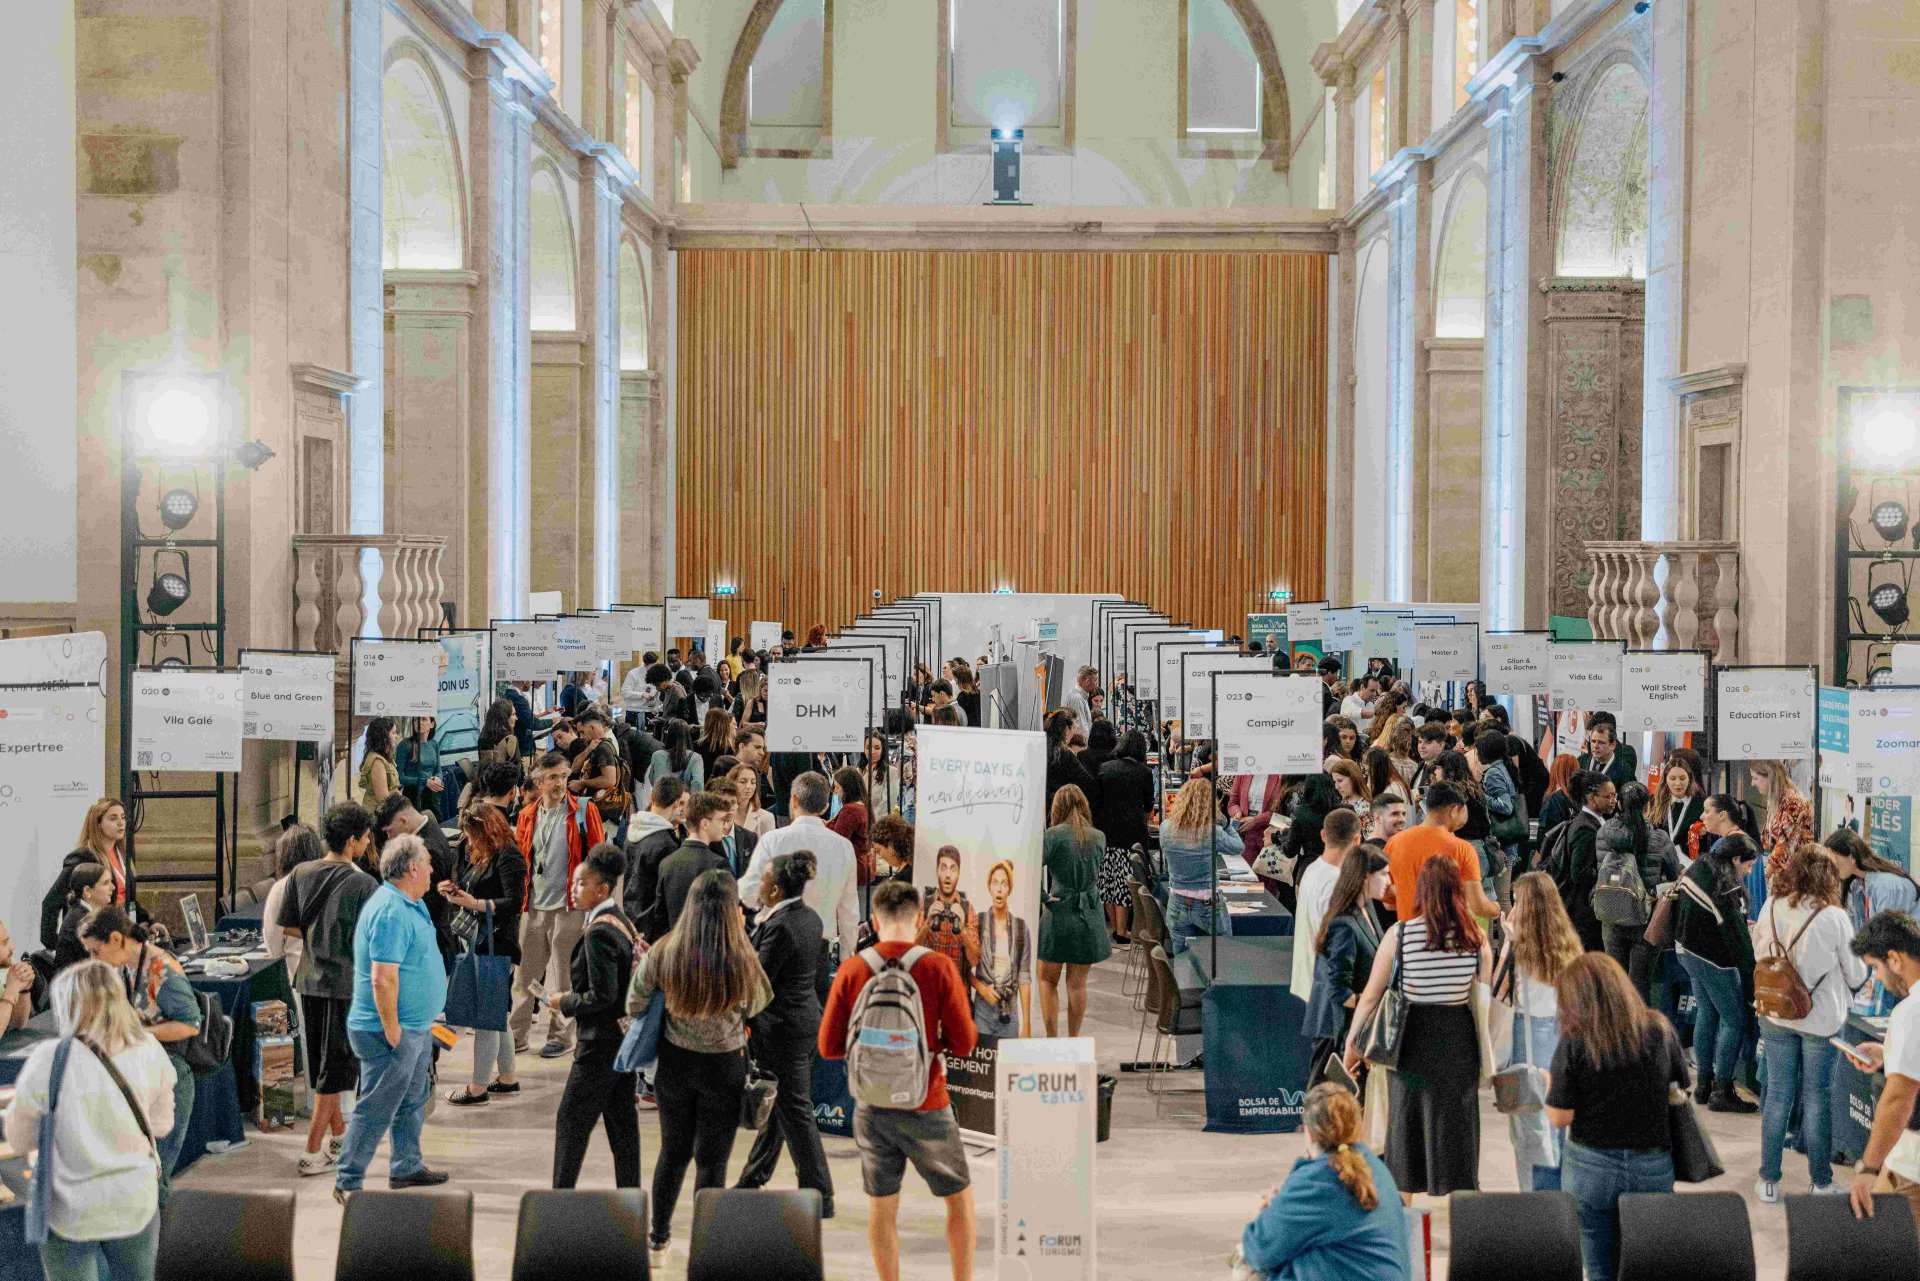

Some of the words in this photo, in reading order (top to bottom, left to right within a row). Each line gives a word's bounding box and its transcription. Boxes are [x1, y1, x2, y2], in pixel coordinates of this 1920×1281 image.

[437, 680, 457, 692] JOIN
[458, 678, 470, 690] US
[251, 691, 271, 700] Blue
[273, 692, 293, 701] and
[294, 693, 323, 702] Green
[1226, 693, 1243, 701] 023
[1649, 692, 1679, 701] English
[796, 704, 836, 718] DHM
[1729, 710, 1778, 719] Education
[1779, 710, 1801, 719] First
[1859, 709, 1877, 717] 024
[163, 715, 184, 725] Vila
[187, 715, 214, 725] Galé
[1246, 718, 1295, 729] Campigir
[0, 742, 64, 755] Expertree
[929, 758, 970, 773] EVERY
[973, 761, 999, 775] DAY
[1002, 763, 1013, 777] IS
[1015, 765, 1026, 778] A
[1238, 1097, 1267, 1107] BOLSA
[1268, 1097, 1280, 1106] DE
